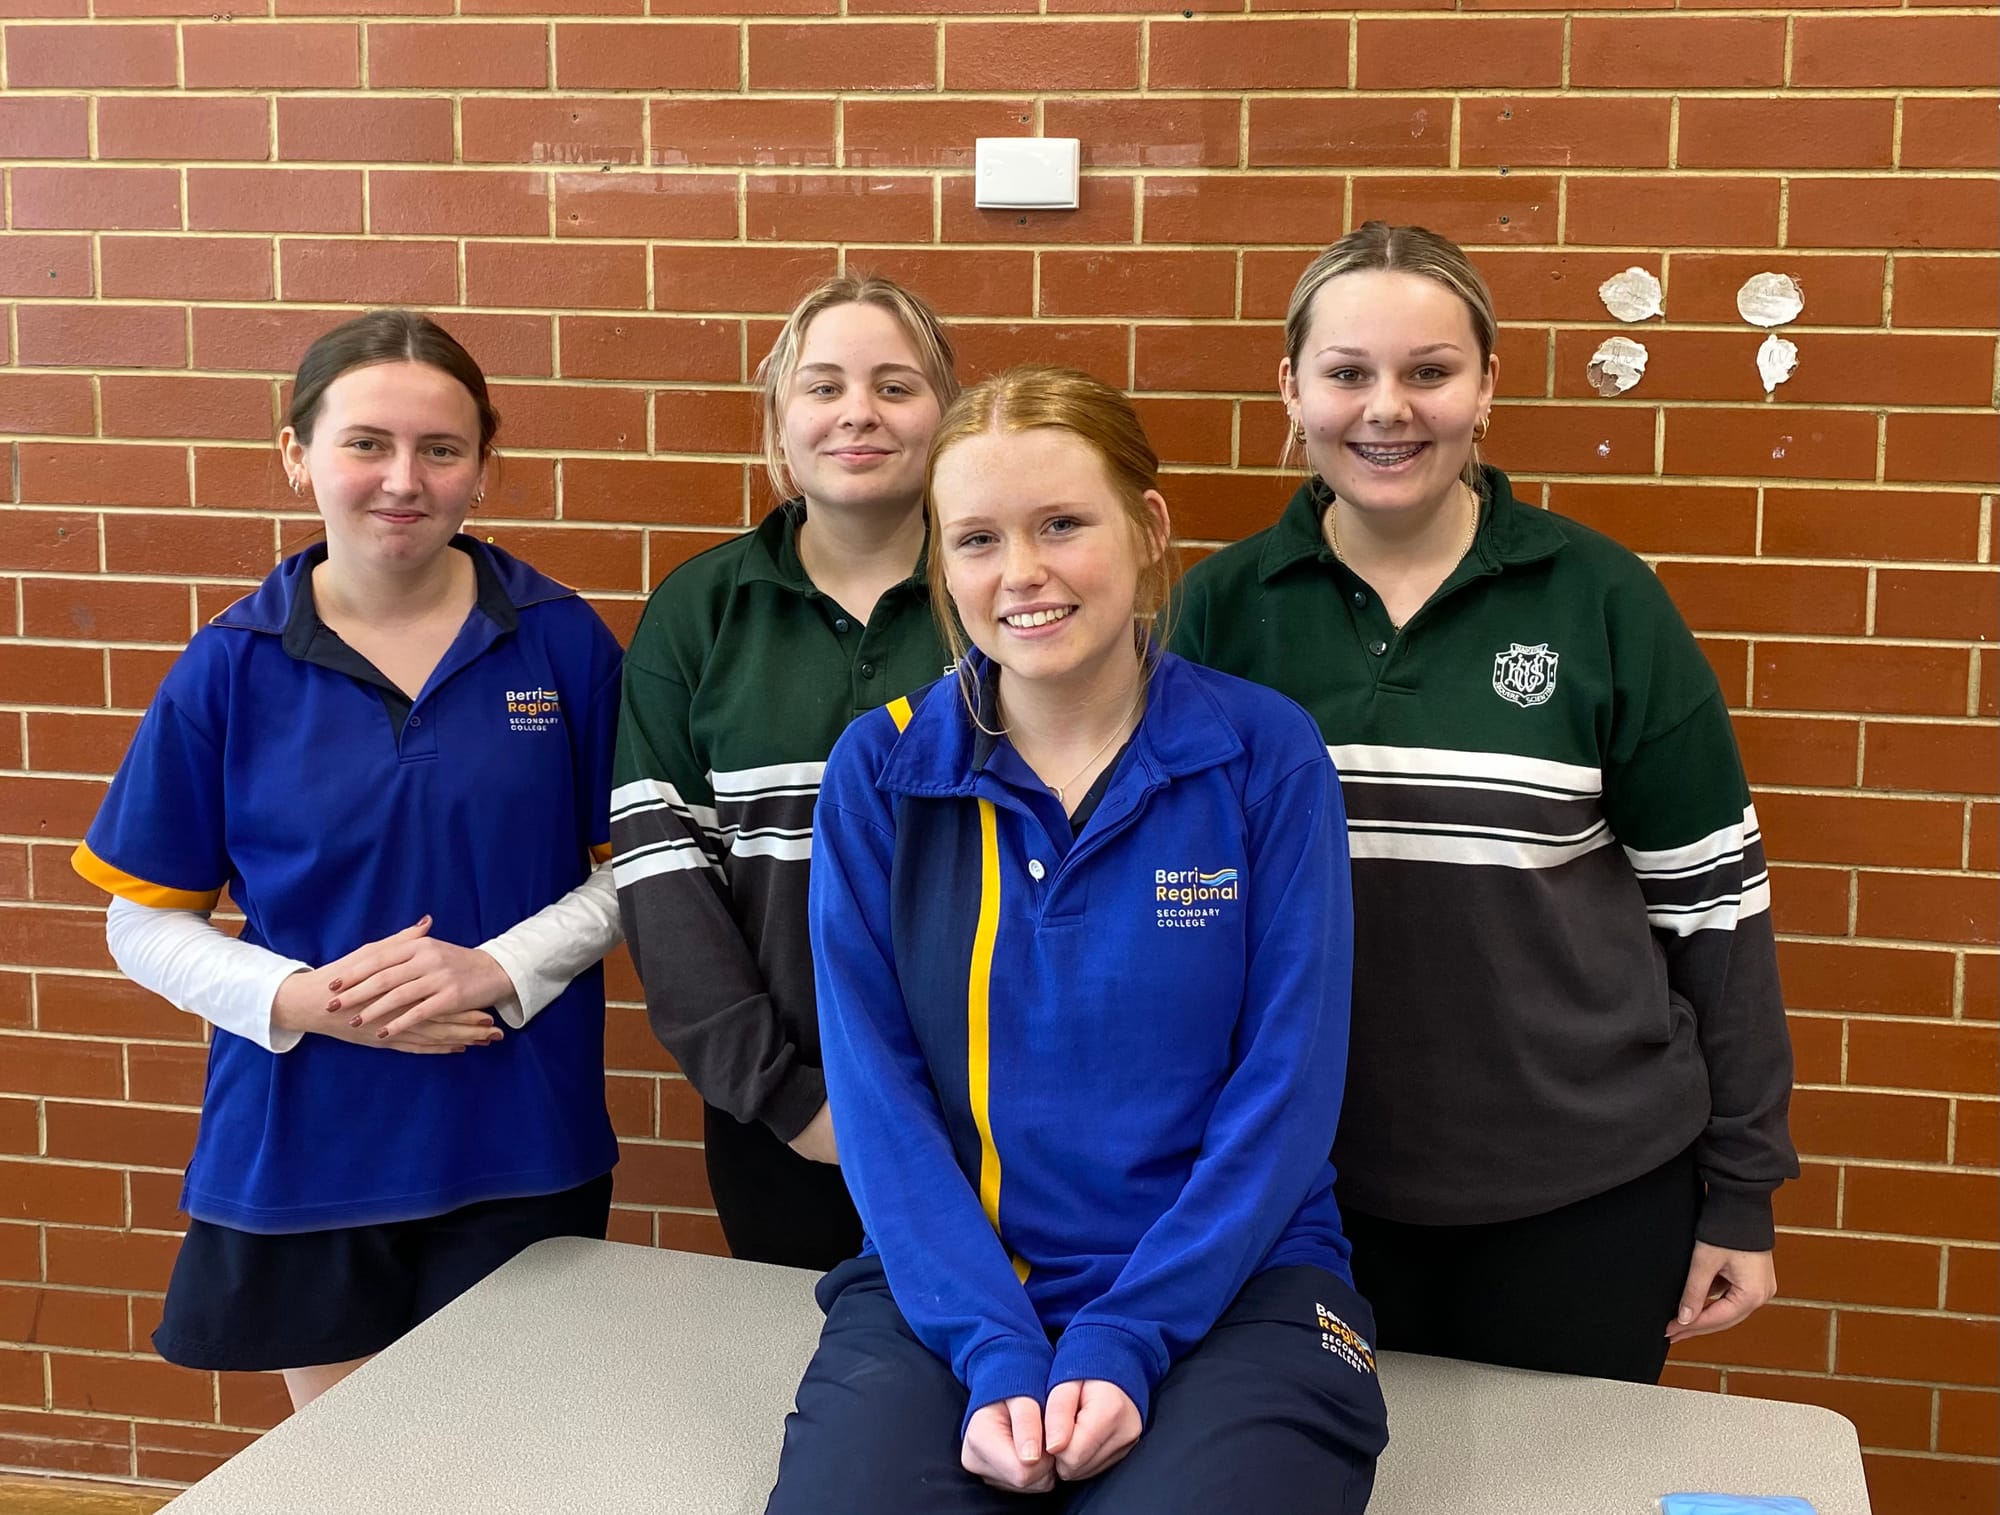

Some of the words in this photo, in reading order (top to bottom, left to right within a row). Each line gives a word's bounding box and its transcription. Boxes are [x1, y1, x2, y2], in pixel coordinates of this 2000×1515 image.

[505, 686, 542, 701] Berri
[507, 700, 560, 716] Region
[509, 717, 559, 725] SECONDARY
[510, 724, 547, 732] COLLEGE
[1155, 866, 1198, 884] Berri
[1156, 880, 1238, 906] Regional
[1156, 908, 1220, 918] SECONDARY
[1157, 918, 1206, 928] COLLEGE
